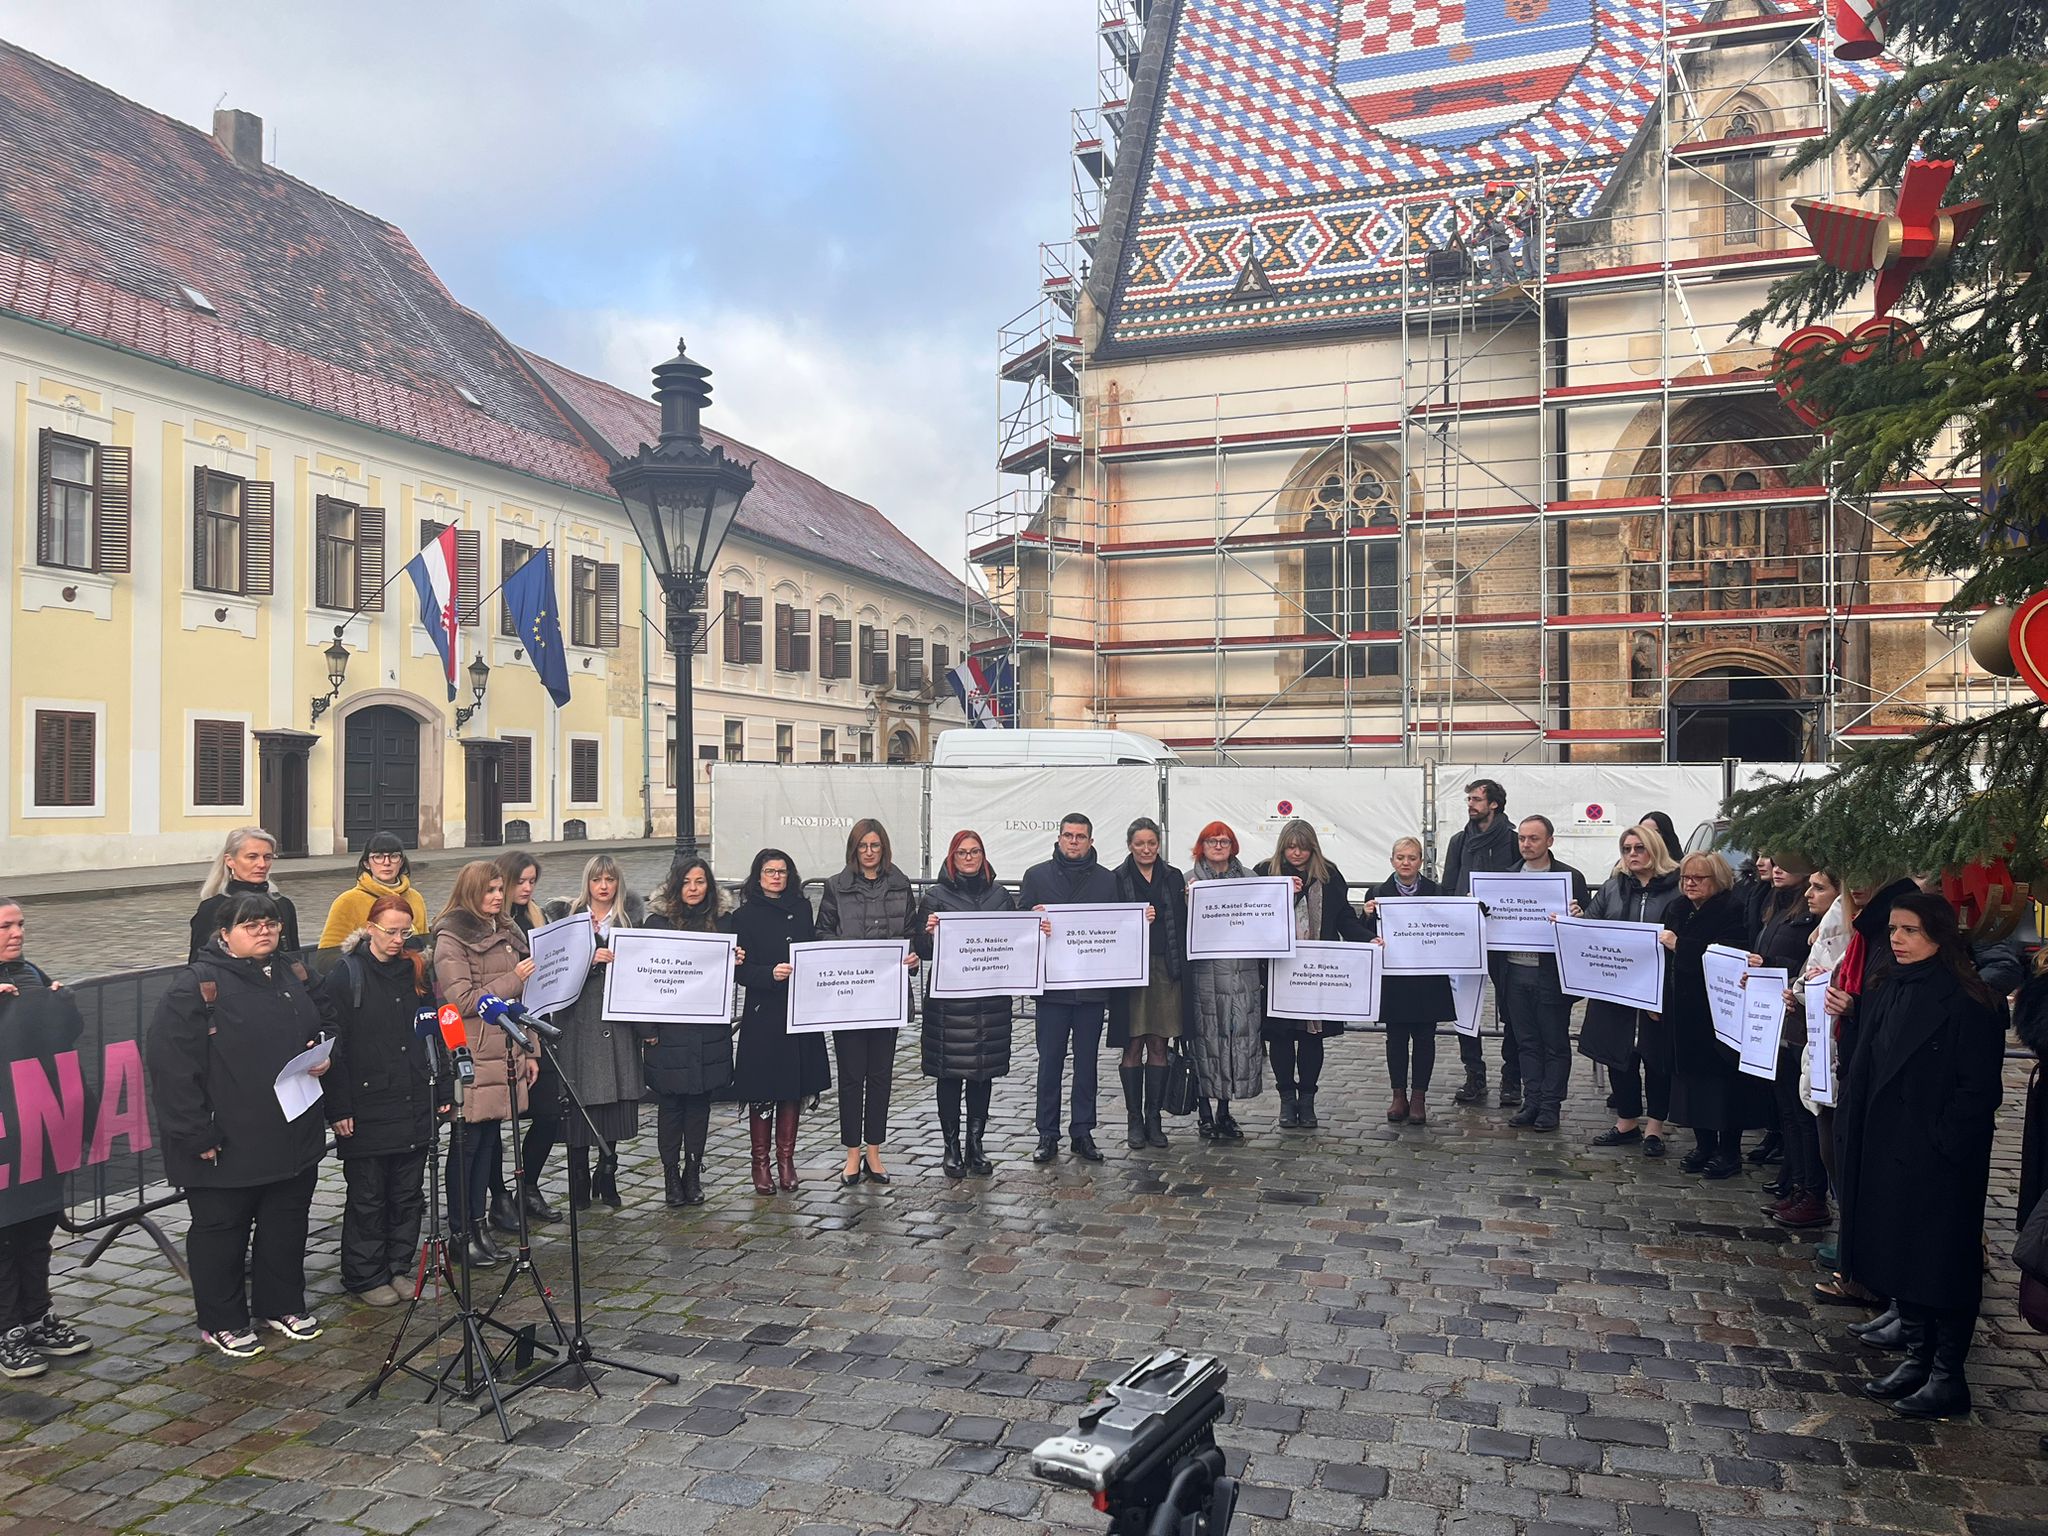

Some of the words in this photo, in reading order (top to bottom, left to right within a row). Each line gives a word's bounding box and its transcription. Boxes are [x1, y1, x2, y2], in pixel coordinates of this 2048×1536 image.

[1421, 938, 1437, 946] (sin)
[959, 946, 985, 954] Ubijena
[987, 945, 1014, 953] hladnim
[1077, 947, 1107, 955] (partner)
[1602, 946, 1622, 954] PULA
[650, 957, 673, 965] 14.01.
[972, 955, 1000, 963] oružjem
[637, 966, 667, 975] Ubijena
[669, 968, 704, 976] vatrenim
[981, 963, 1009, 972] partner)
[837, 969, 854, 977] Vela
[856, 968, 874, 976] Luka
[653, 977, 685, 985] oružjem
[816, 979, 850, 988] Izbodena
[851, 977, 875, 985] nožem
[1319, 980, 1352, 988] poznanik)
[660, 986, 678, 995] (sin)
[837, 988, 854, 996] (sin)
[0, 1039, 153, 1191] NA
